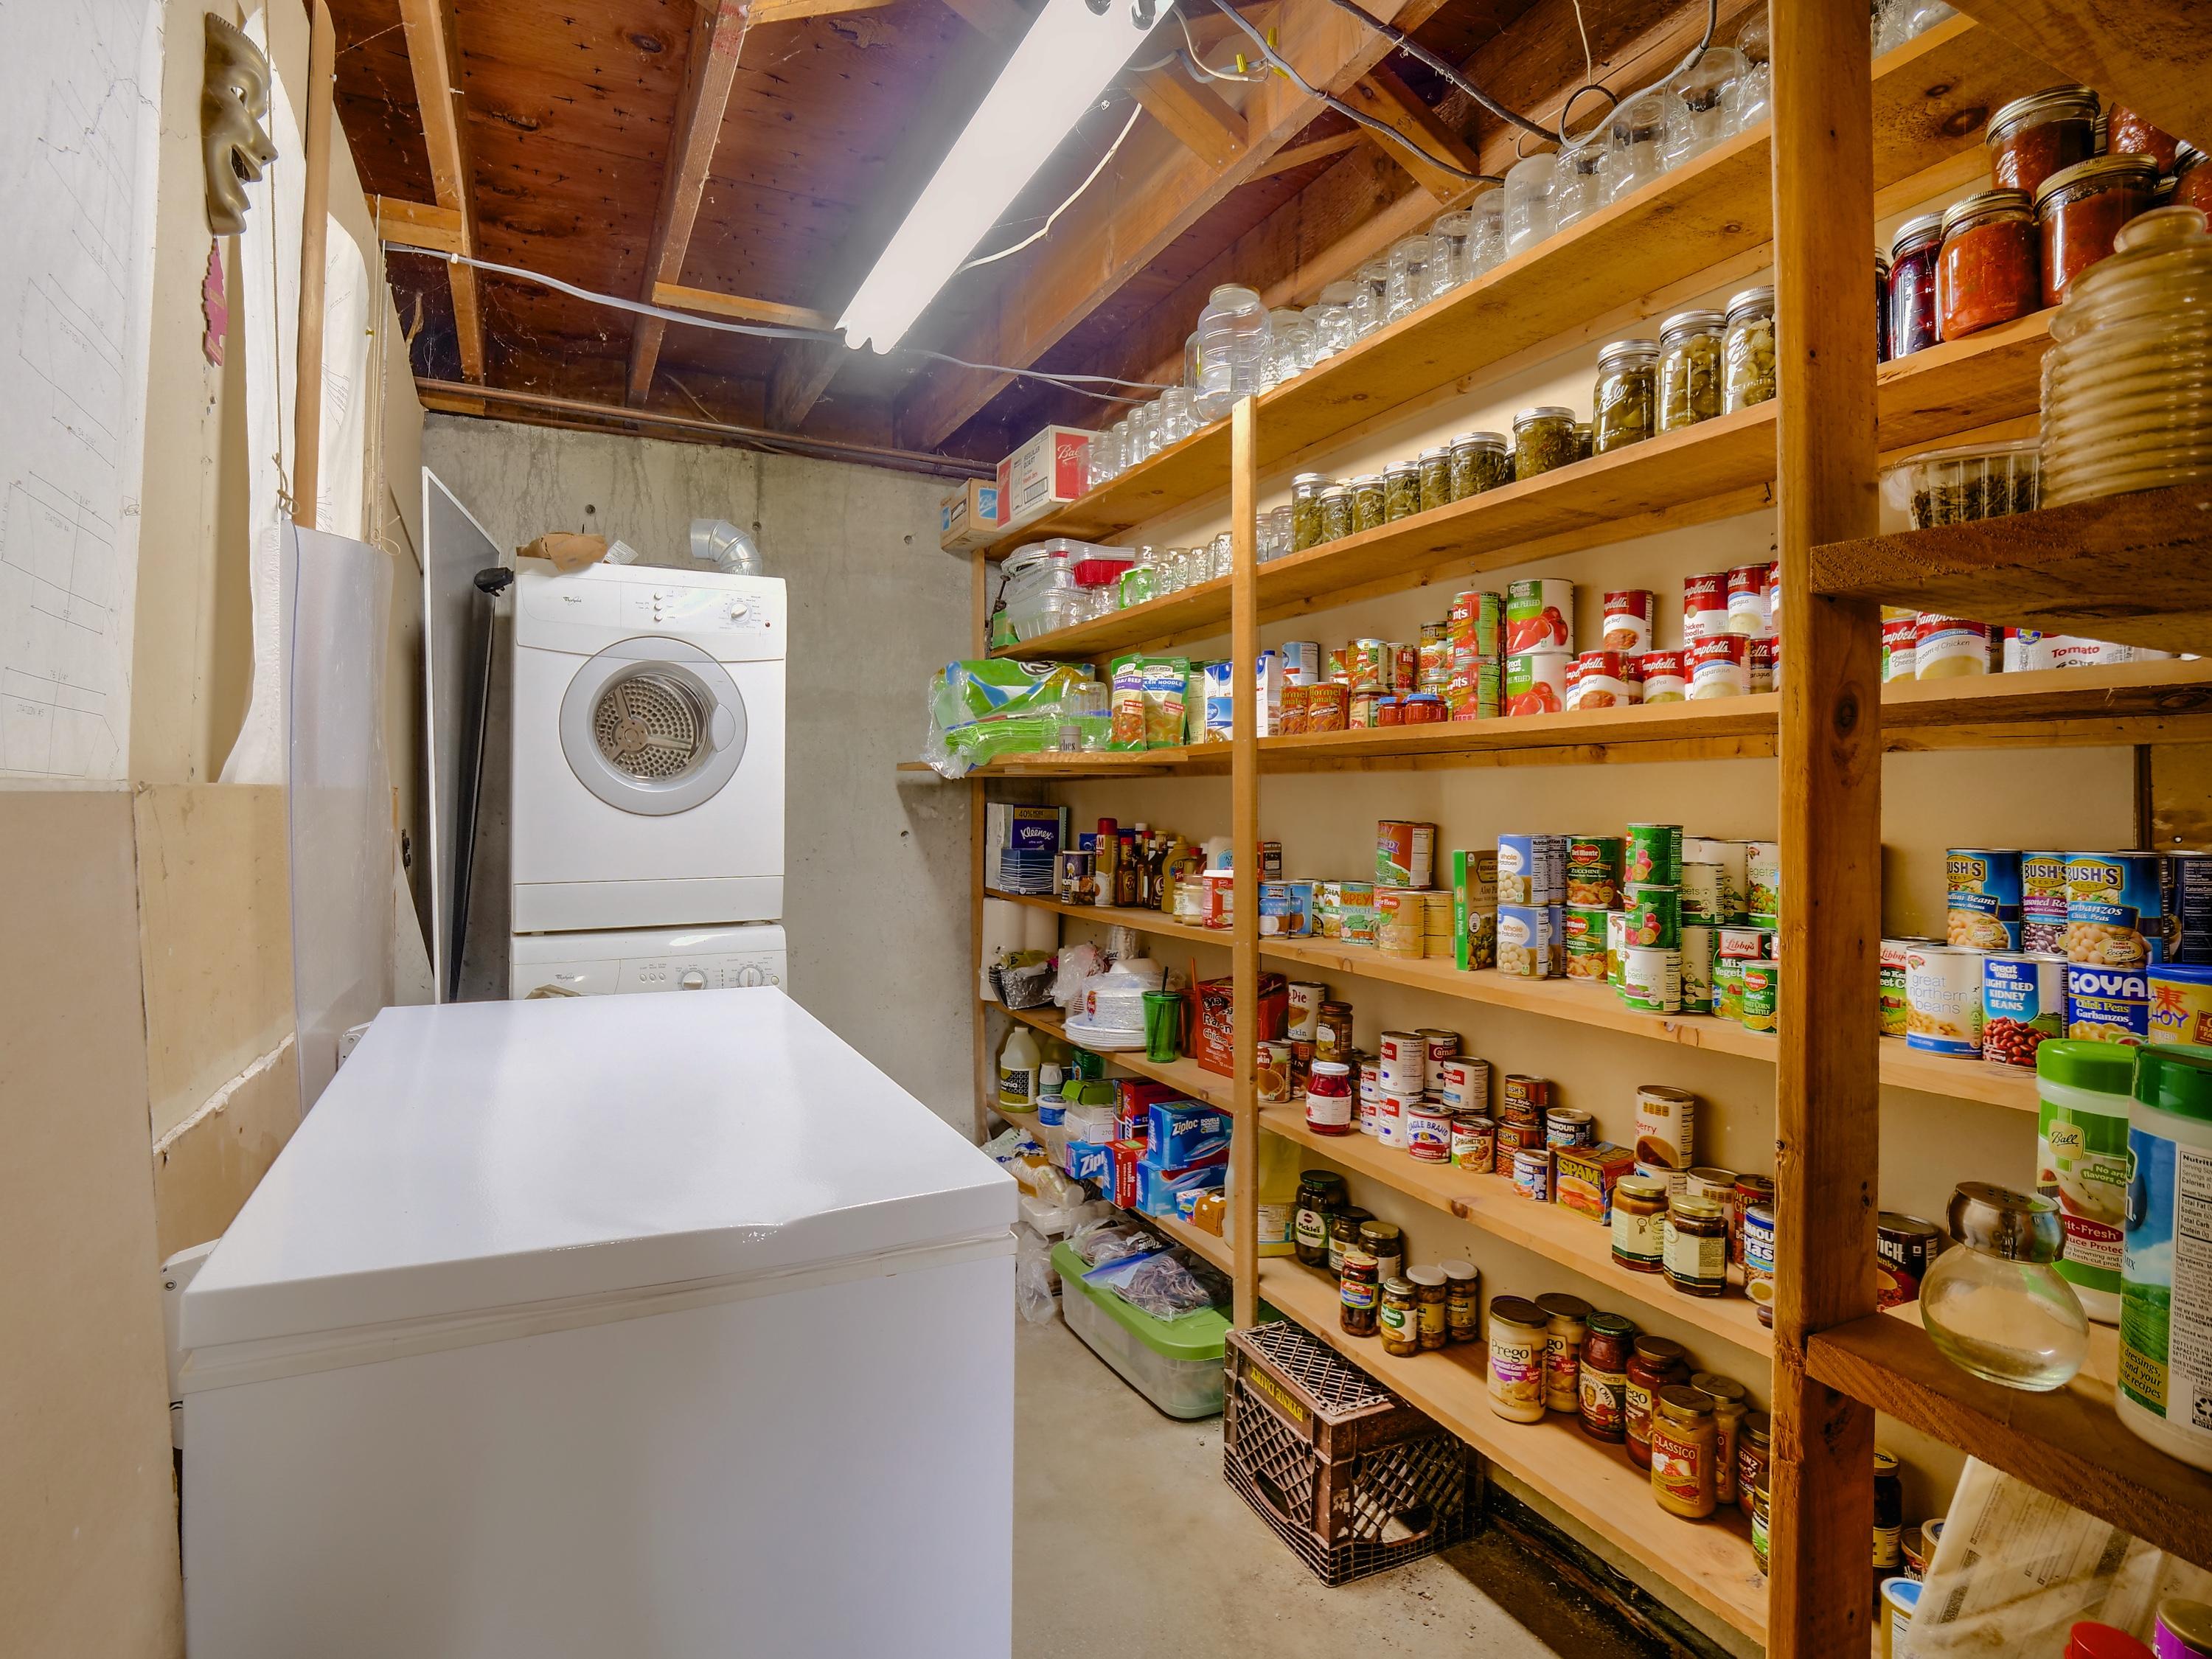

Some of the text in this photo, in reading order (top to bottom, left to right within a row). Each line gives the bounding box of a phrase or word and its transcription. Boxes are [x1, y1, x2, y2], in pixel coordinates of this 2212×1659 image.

[1023, 445, 1040, 461] REGULAR
[1023, 456, 1035, 469] QUART
[1510, 582, 1530, 594] Great
[1520, 599, 1540, 608] PEELED
[1937, 630, 1968, 639] COOKING
[1941, 640, 1970, 650] Chicken
[2051, 645, 2100, 658] Tomato
[1310, 688, 1341, 697] Hormel
[1311, 696, 1340, 704] Tamales
[1018, 810, 1032, 818] 40%
[1020, 826, 1051, 841] Kleenex
[2025, 862, 2067, 880] BUSH'S
[2067, 866, 2118, 885] BUSH'S
[1682, 887, 1700, 896] eets
[1967, 895, 1997, 905] Beans
[2067, 902, 2123, 916] Garbanzos
[2090, 914, 2110, 922] Peas
[1503, 925, 1523, 933] Whole
[1725, 938, 1755, 952] Libby's
[2107, 948, 2135, 957] Recipes
[1989, 962, 2018, 974] Great
[1627, 970, 1648, 981] beets
[1912, 974, 1947, 987] great
[1994, 971, 2018, 980] Value
[1986, 978, 2034, 992] LIGHT RED
[2069, 971, 2145, 998] GOYA
[1292, 989, 1307, 1003] Pie
[1910, 986, 1968, 1003] northern
[1989, 989, 2025, 1000] KIDNEY
[1916, 1000, 1961, 1015] beans
[1991, 999, 2024, 1011] BEANS
[2076, 998, 2129, 1013] Chick Peas
[2076, 1008, 2129, 1023] Garbanzos
[2149, 1009, 2191, 1028] HOY
[1172, 1118, 1199, 1137] Ziploc
[1408, 1120, 1448, 1137] EAGLE BRAND
[2051, 1131, 2079, 1144] Ball
[1558, 1158, 1599, 1187] SPAM
[2096, 1166, 2108, 1174] No
[2183, 1162, 2202, 1172] Serving
[2083, 1170, 2114, 1183] flavors
[2183, 1169, 2205, 1180] Servings
[2182, 1177, 2205, 1189] Calories
[2182, 1197, 2206, 1210] Total Fat
[2181, 1206, 2202, 1217] Sodium
[1298, 1221, 1321, 1234] Pickles
[2180, 1215, 2210, 1229] Total Carb
[2065, 1220, 2117, 1241] uit-Fresh
[2180, 1224, 2200, 1235] Protein
[2072, 1253, 2103, 1266] fresh-cut
[2073, 1247, 2105, 1260] browning
[2124, 1255, 2135, 1270] MIX
[2173, 1338, 2192, 1349] BOTTLE
[1492, 1338, 1529, 1363] Prego
[2124, 1347, 2161, 1377] dressings,
[2172, 1358, 2203, 1373] QUESTIONS
[2126, 1361, 2163, 1387] and your
[2131, 1375, 2161, 1399] recipes
[1251, 1366, 1304, 1422] BYRNE DAIRY
[1599, 1387, 1613, 1408] OWN
[1654, 1433, 1696, 1460] CLASSICO
